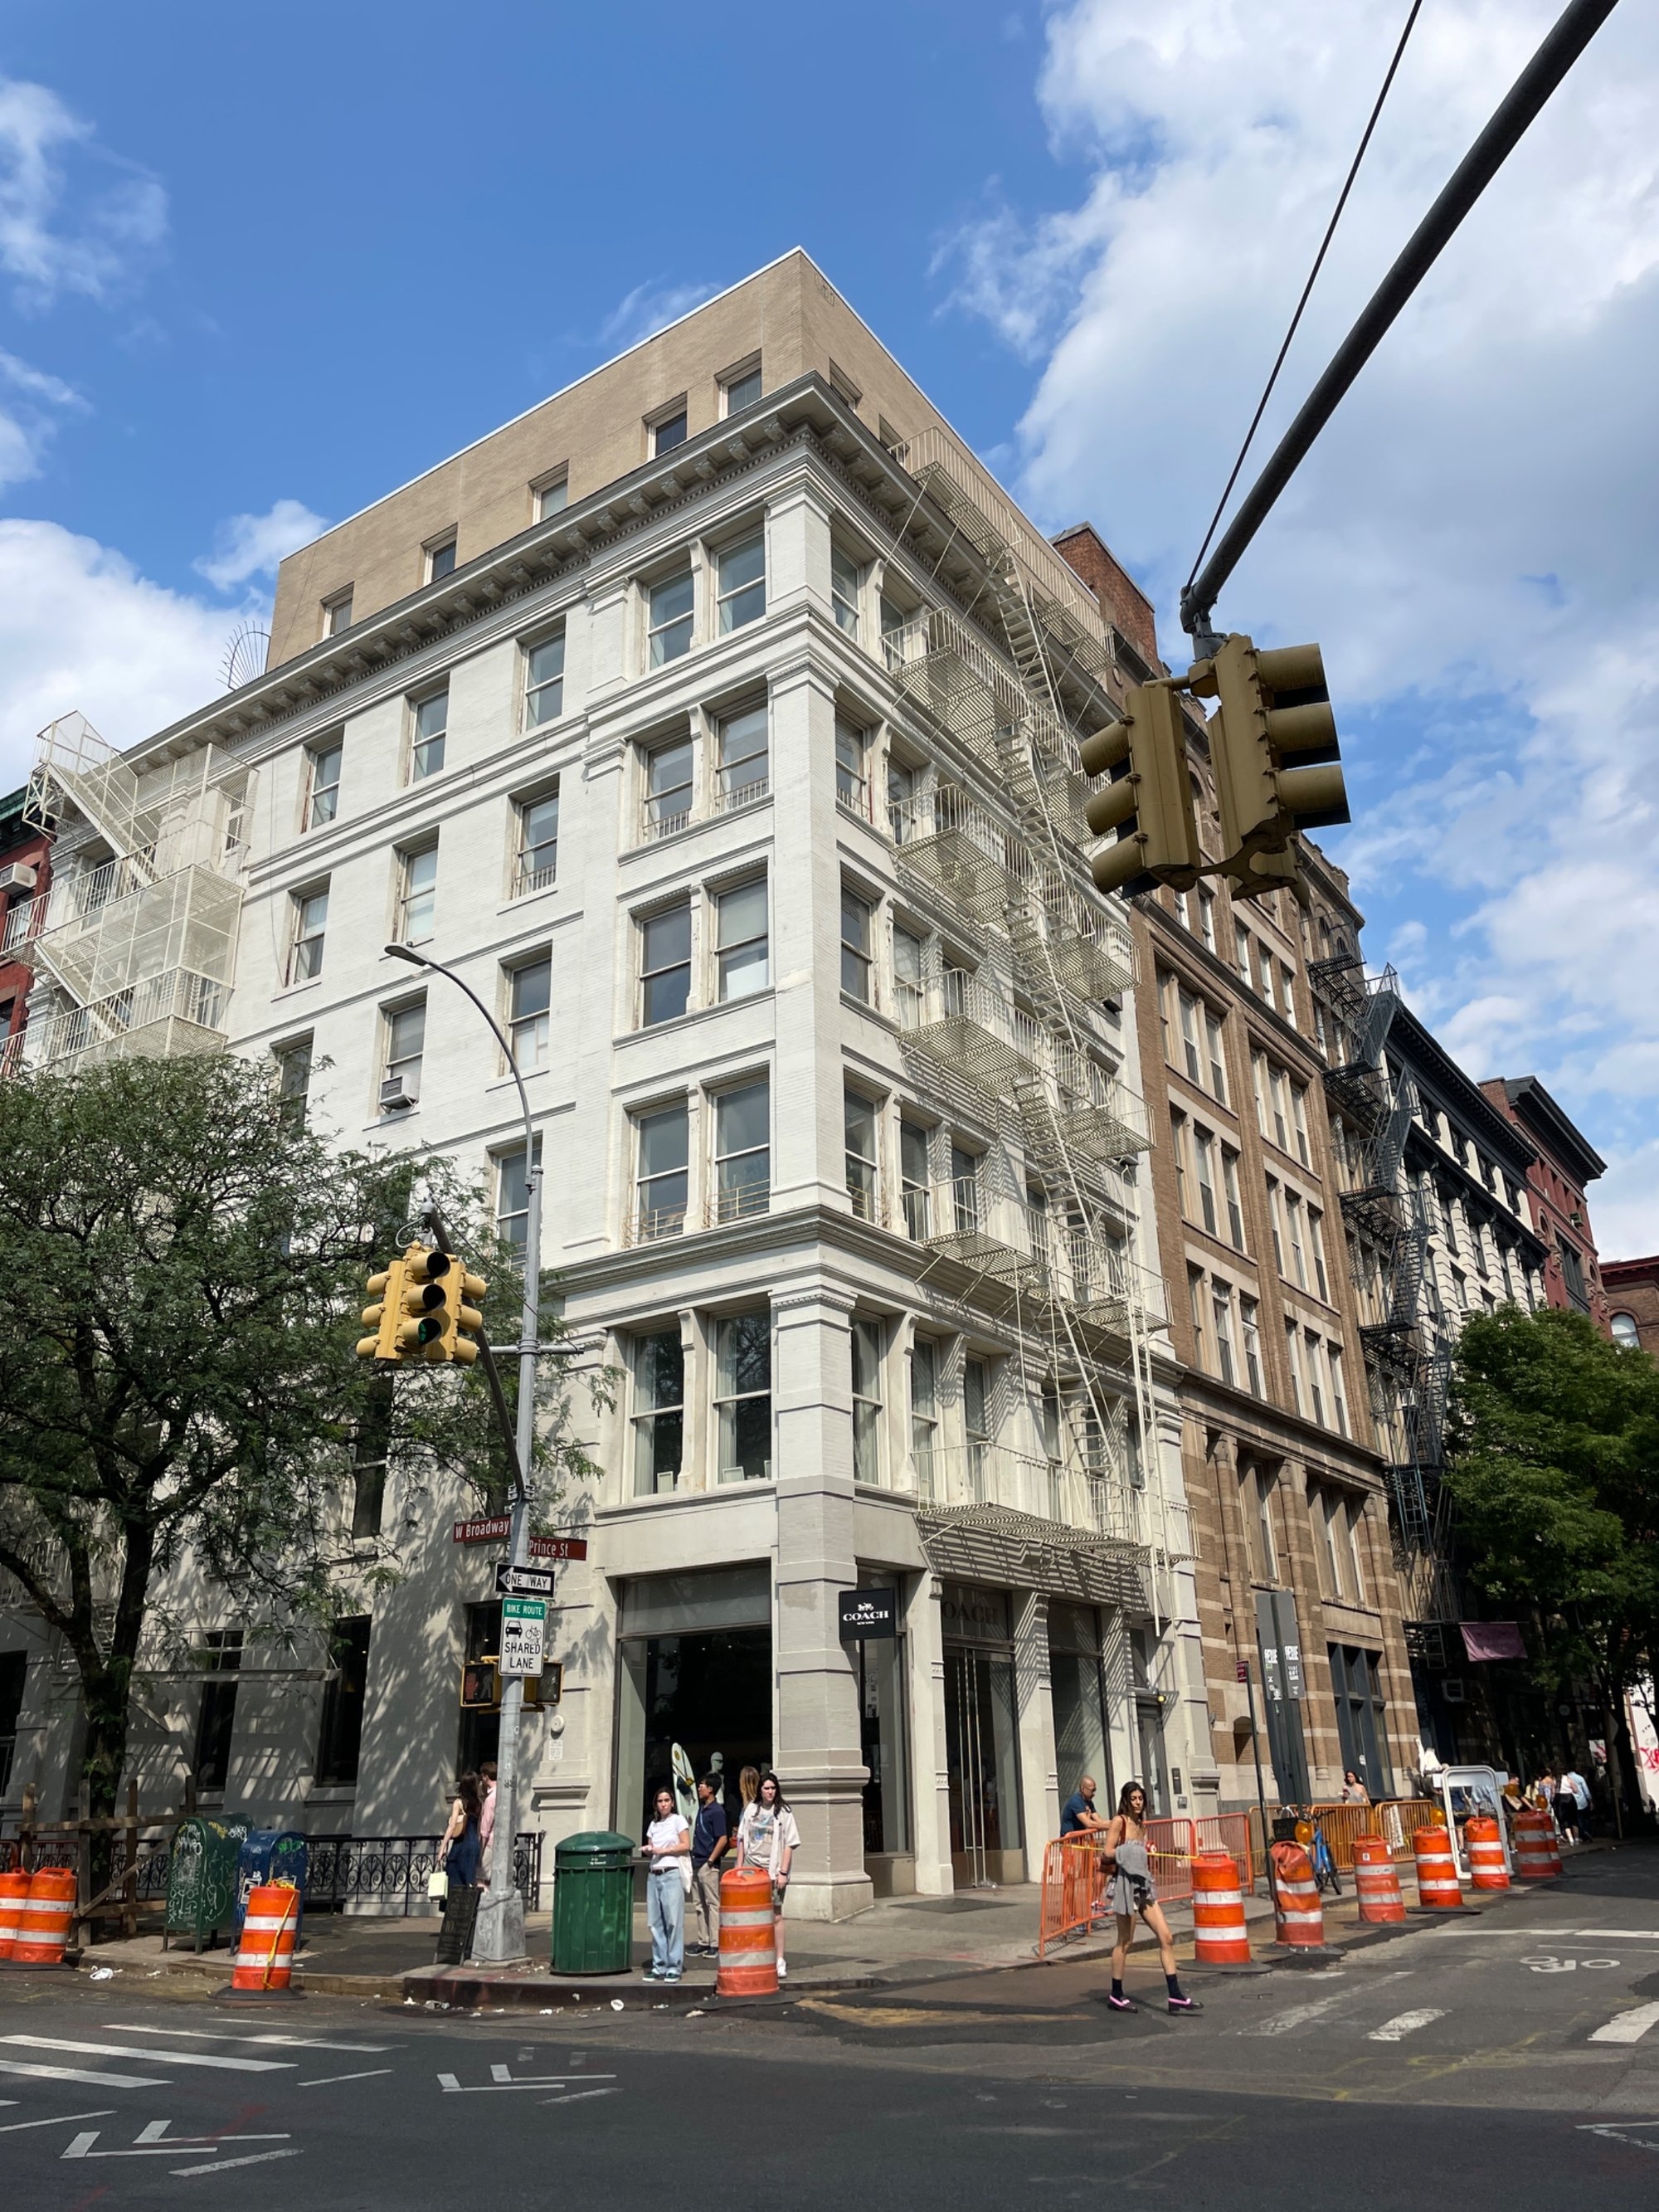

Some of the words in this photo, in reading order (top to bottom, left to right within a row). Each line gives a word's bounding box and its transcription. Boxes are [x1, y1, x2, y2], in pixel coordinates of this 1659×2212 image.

[455, 1526, 463, 1538] W
[465, 1519, 509, 1537] Broadway
[528, 1540, 557, 1556] Prince
[560, 1542, 569, 1557] St
[505, 1573, 523, 1586] ONE
[530, 1576, 547, 1589] WAY
[506, 1604, 520, 1614] BIKE
[523, 1605, 542, 1616] ROUTE
[843, 1610, 889, 1622] COACH
[941, 1601, 999, 1625] OACH
[504, 1642, 541, 1654] SHARED
[509, 1656, 533, 1669] LANE
